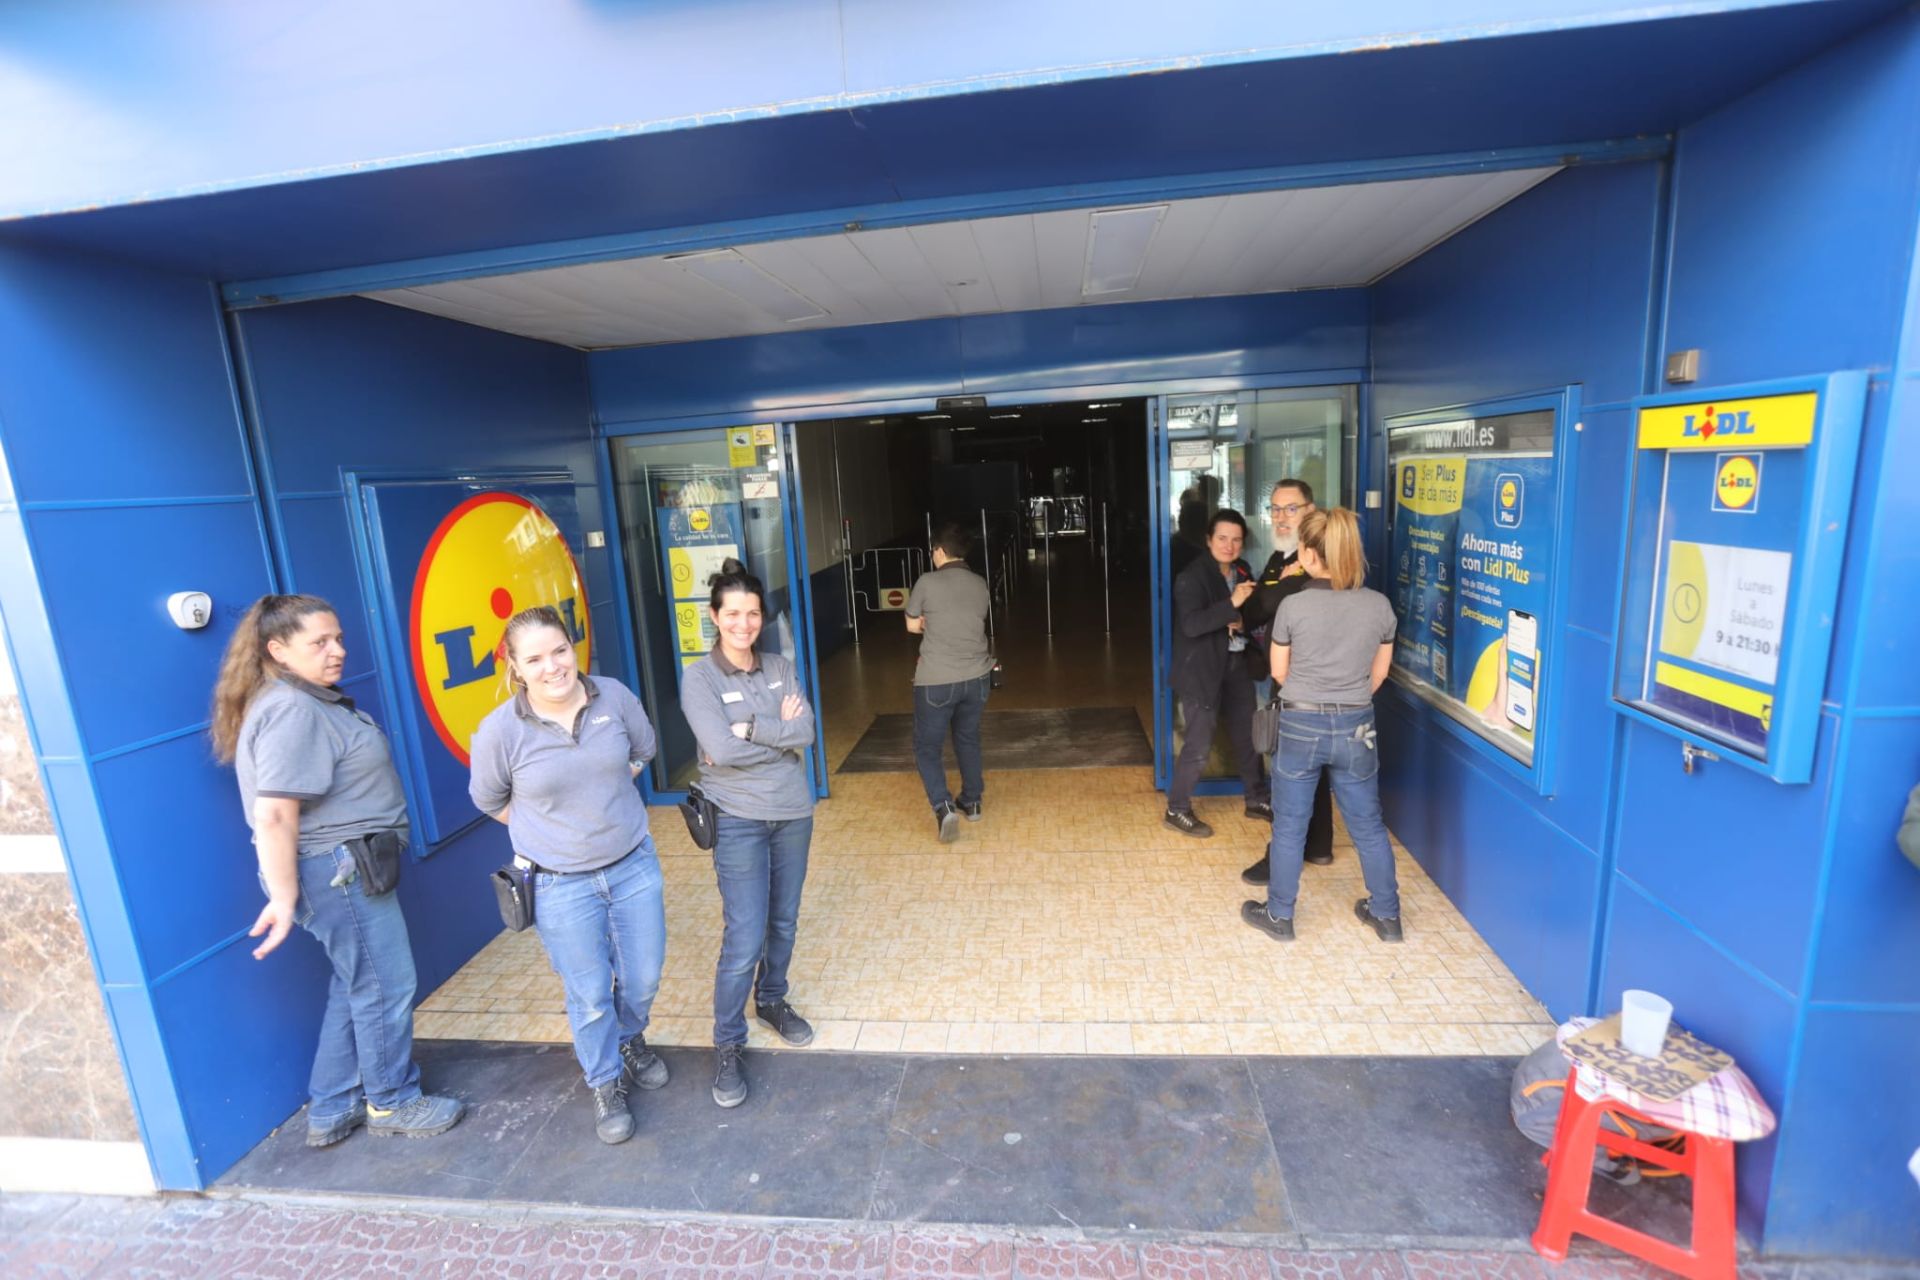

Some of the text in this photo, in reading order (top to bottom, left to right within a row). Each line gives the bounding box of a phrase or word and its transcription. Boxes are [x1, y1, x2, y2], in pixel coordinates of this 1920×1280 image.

[1425, 422, 1495, 449] www.lidl.es
[1436, 464, 1456, 482] Plus
[1461, 532, 1523, 561] Ahorra más
[1461, 556, 1530, 585] con Lidl Plus
[1737, 577, 1774, 596] Lunes
[1749, 599, 1757, 610] a
[1716, 629, 1724, 644] 9
[1726, 635, 1733, 647] a
[1736, 633, 1771, 656] 21:30
